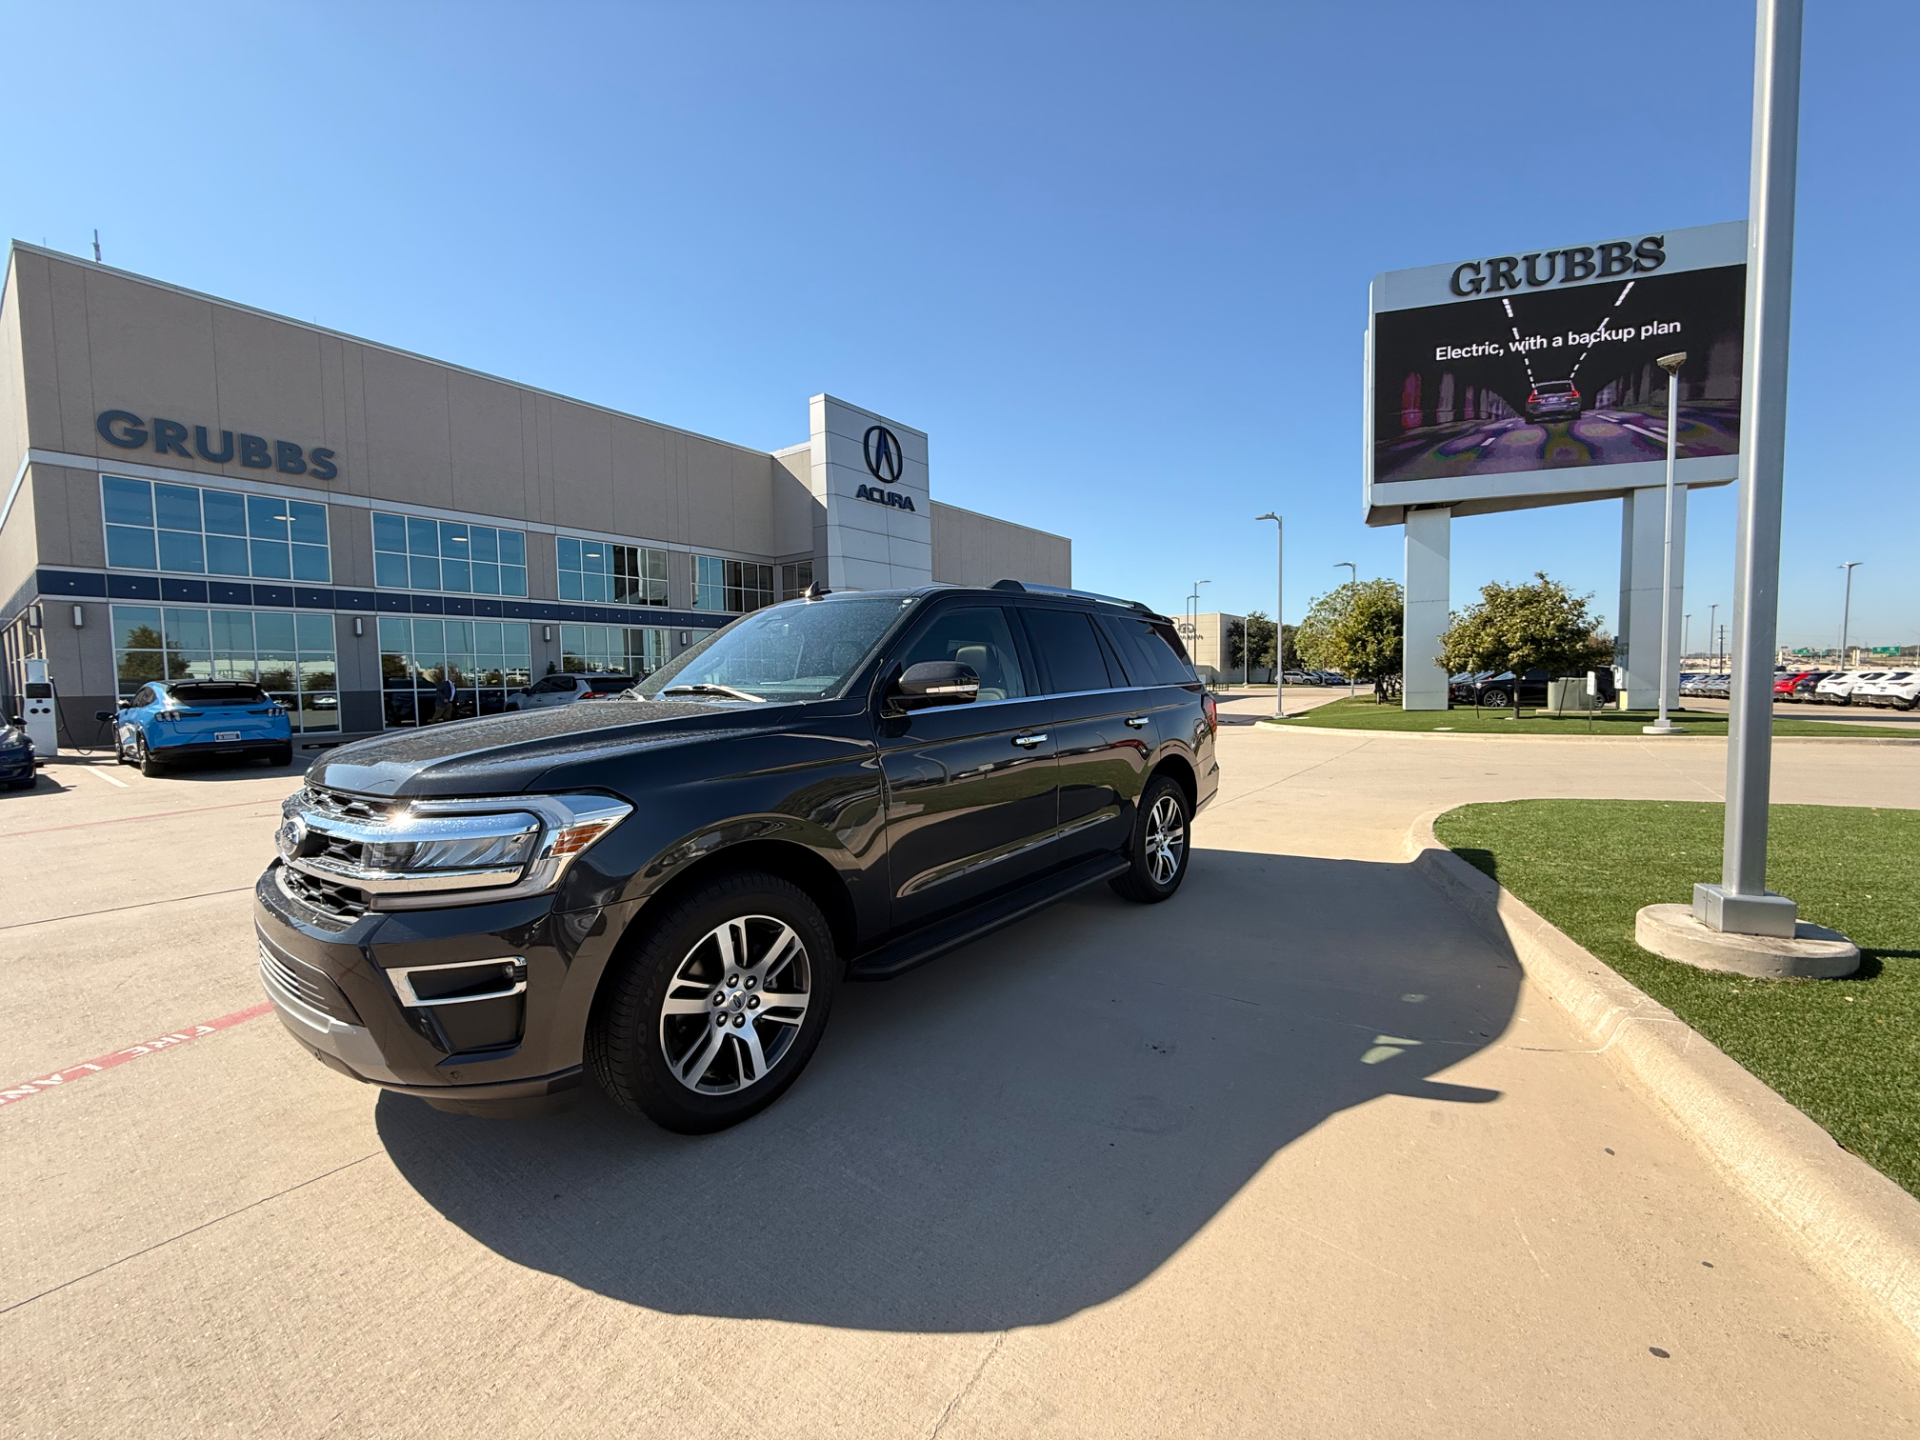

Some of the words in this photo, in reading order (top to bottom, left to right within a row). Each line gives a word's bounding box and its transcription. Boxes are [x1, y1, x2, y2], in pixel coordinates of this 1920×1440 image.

[1450, 234, 1666, 297] GRUBBS
[1435, 340, 1504, 361] Electric,
[1508, 333, 1547, 353] with
[1551, 335, 1563, 348] a
[1568, 325, 1636, 346] backup
[1641, 320, 1682, 342] plan
[96, 409, 339, 480] GRUBBS
[855, 484, 916, 511] ACURA
[118, 1025, 216, 1058] FIRE
[636, 1022, 657, 1087] OYO
[0, 1063, 102, 1105] LAN
